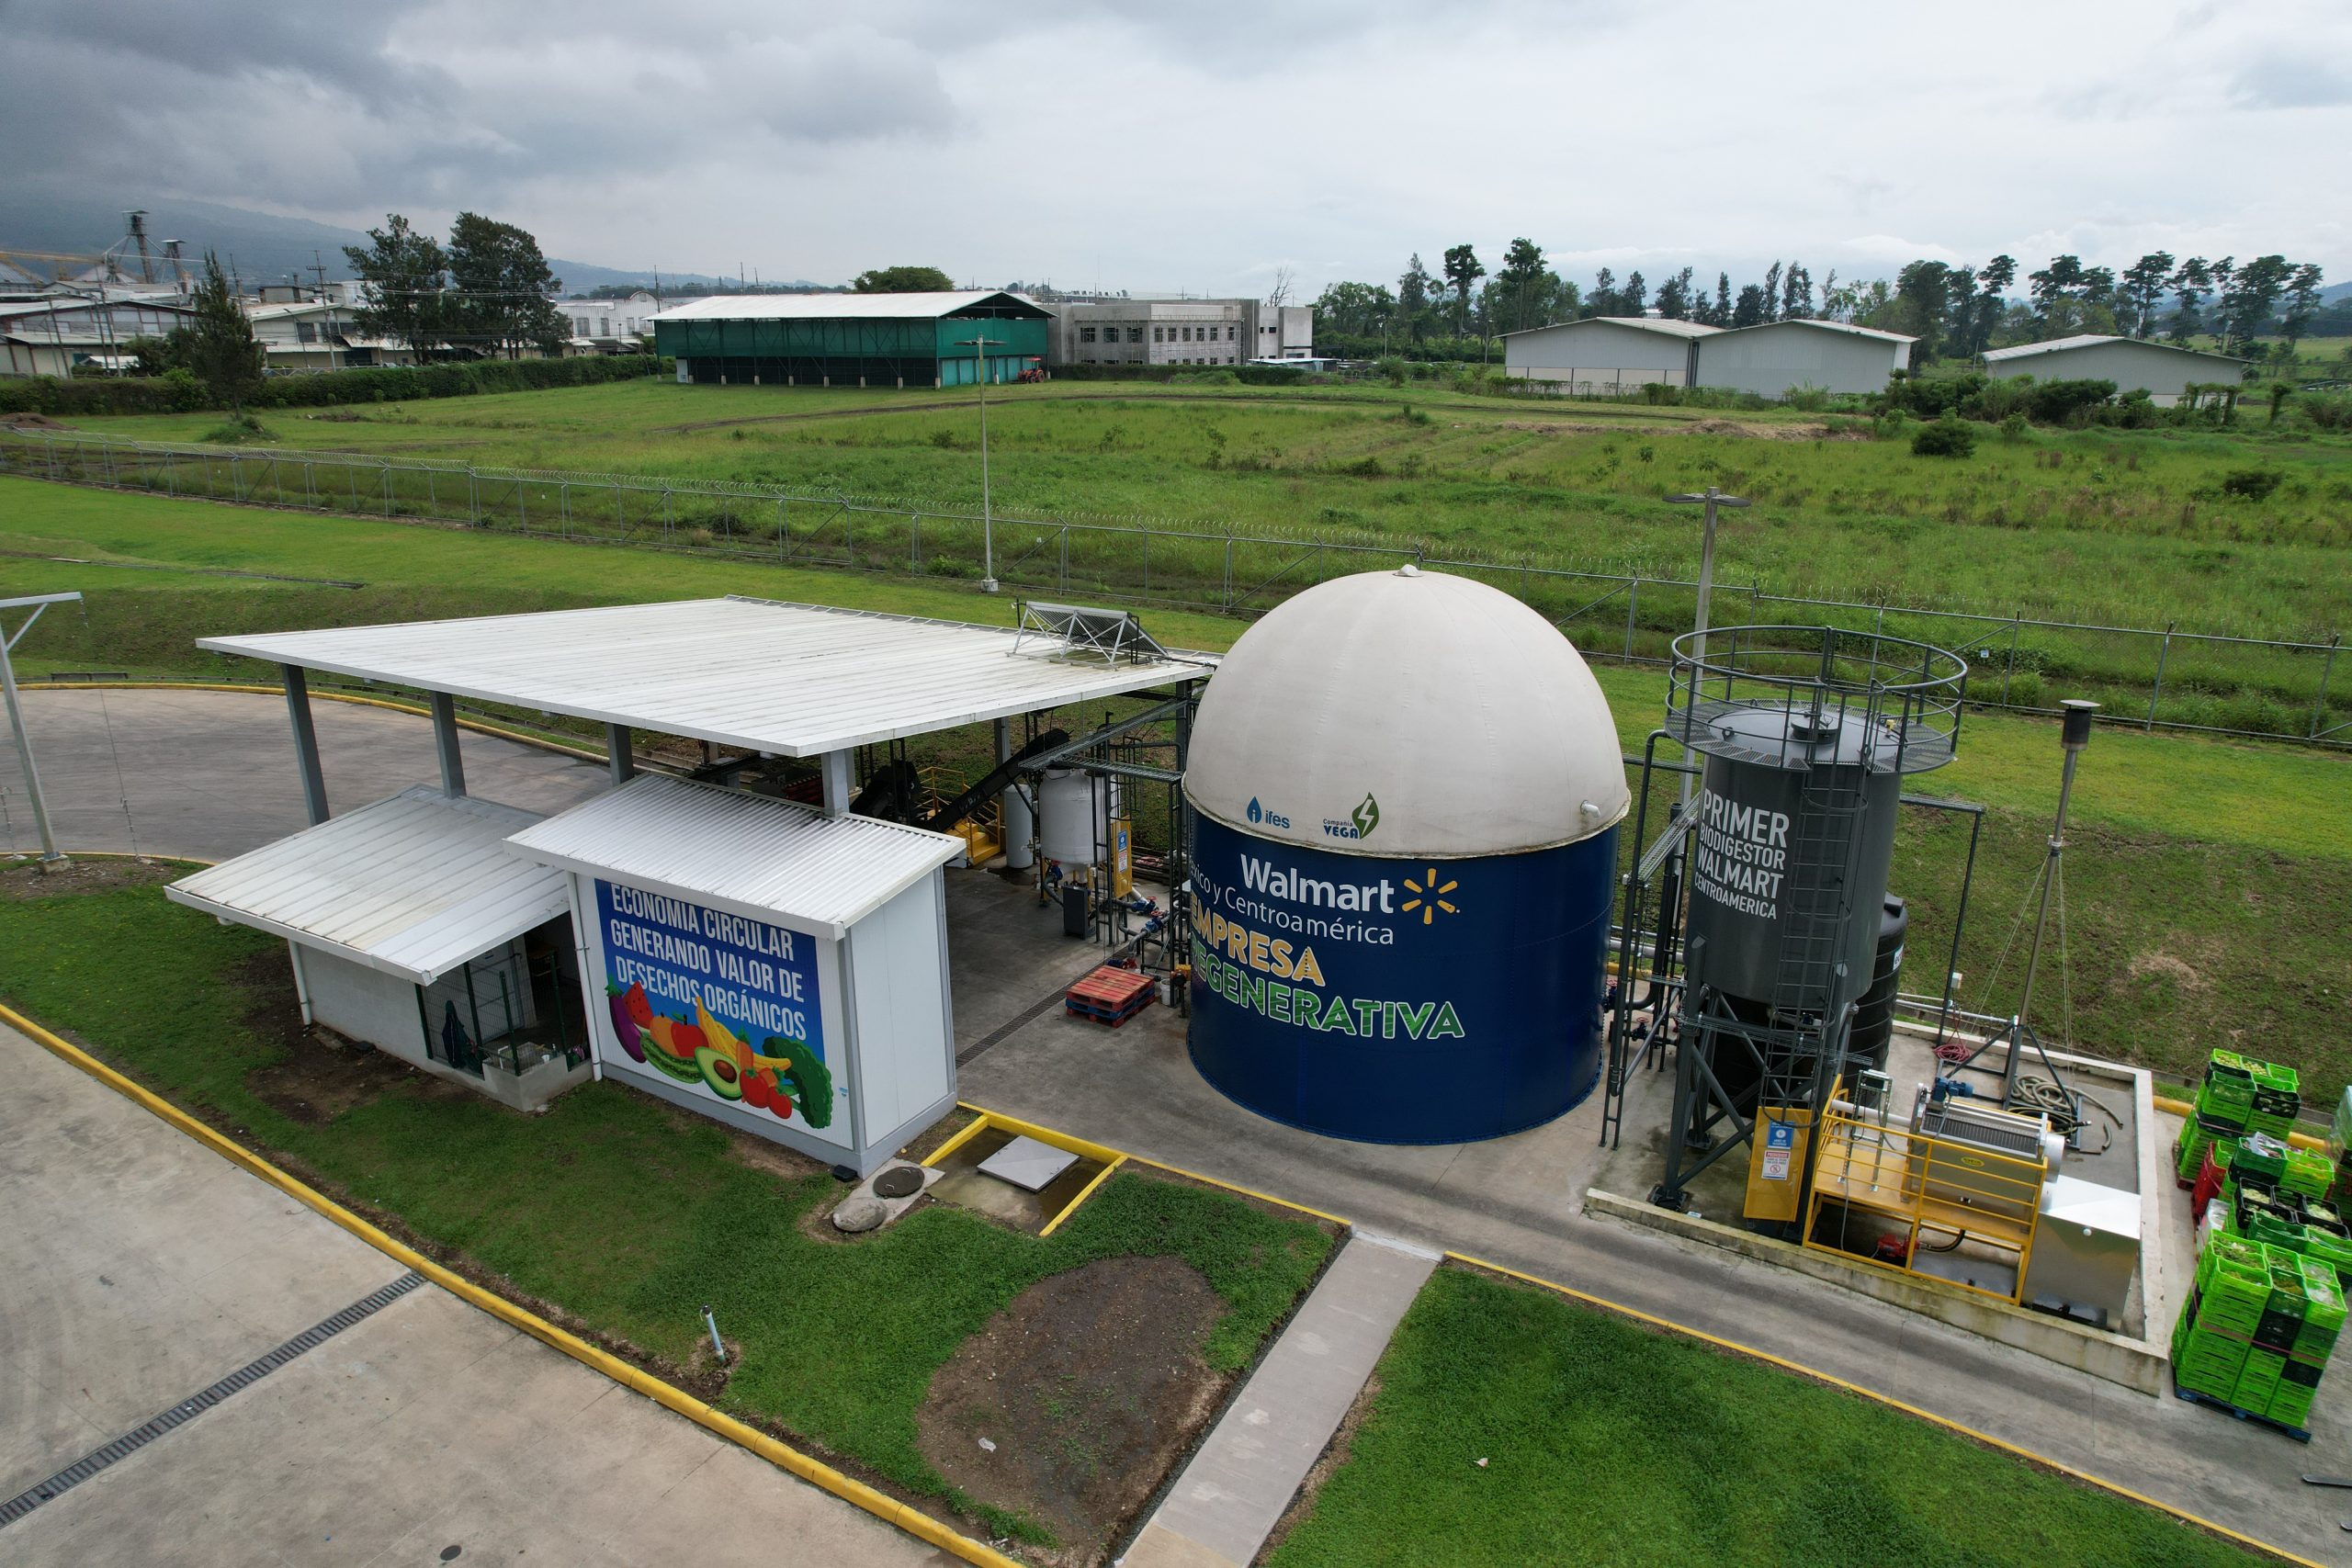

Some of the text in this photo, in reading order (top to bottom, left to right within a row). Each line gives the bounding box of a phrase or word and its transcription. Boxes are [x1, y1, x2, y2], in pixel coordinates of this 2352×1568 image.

[1265, 810, 1291, 829] ifes
[1323, 825, 1359, 840] VEGA
[1700, 821, 1786, 871] BIODIGESTOR
[1702, 787, 1790, 849] PRIMER
[1240, 853, 1395, 914] Walmart
[1694, 871, 1777, 920] CENTROAMERICA
[1697, 841, 1784, 899] WALMART
[610, 882, 795, 962] ECONOMIA CIRCULAR
[1191, 888, 1326, 987] EMPRESA
[1213, 883, 1221, 905] y
[1225, 886, 1394, 945] Centroamérica
[610, 919, 805, 1004] GENERANDO VALOR DE
[615, 954, 808, 1042] DESECHOS ORGÁNICOS
